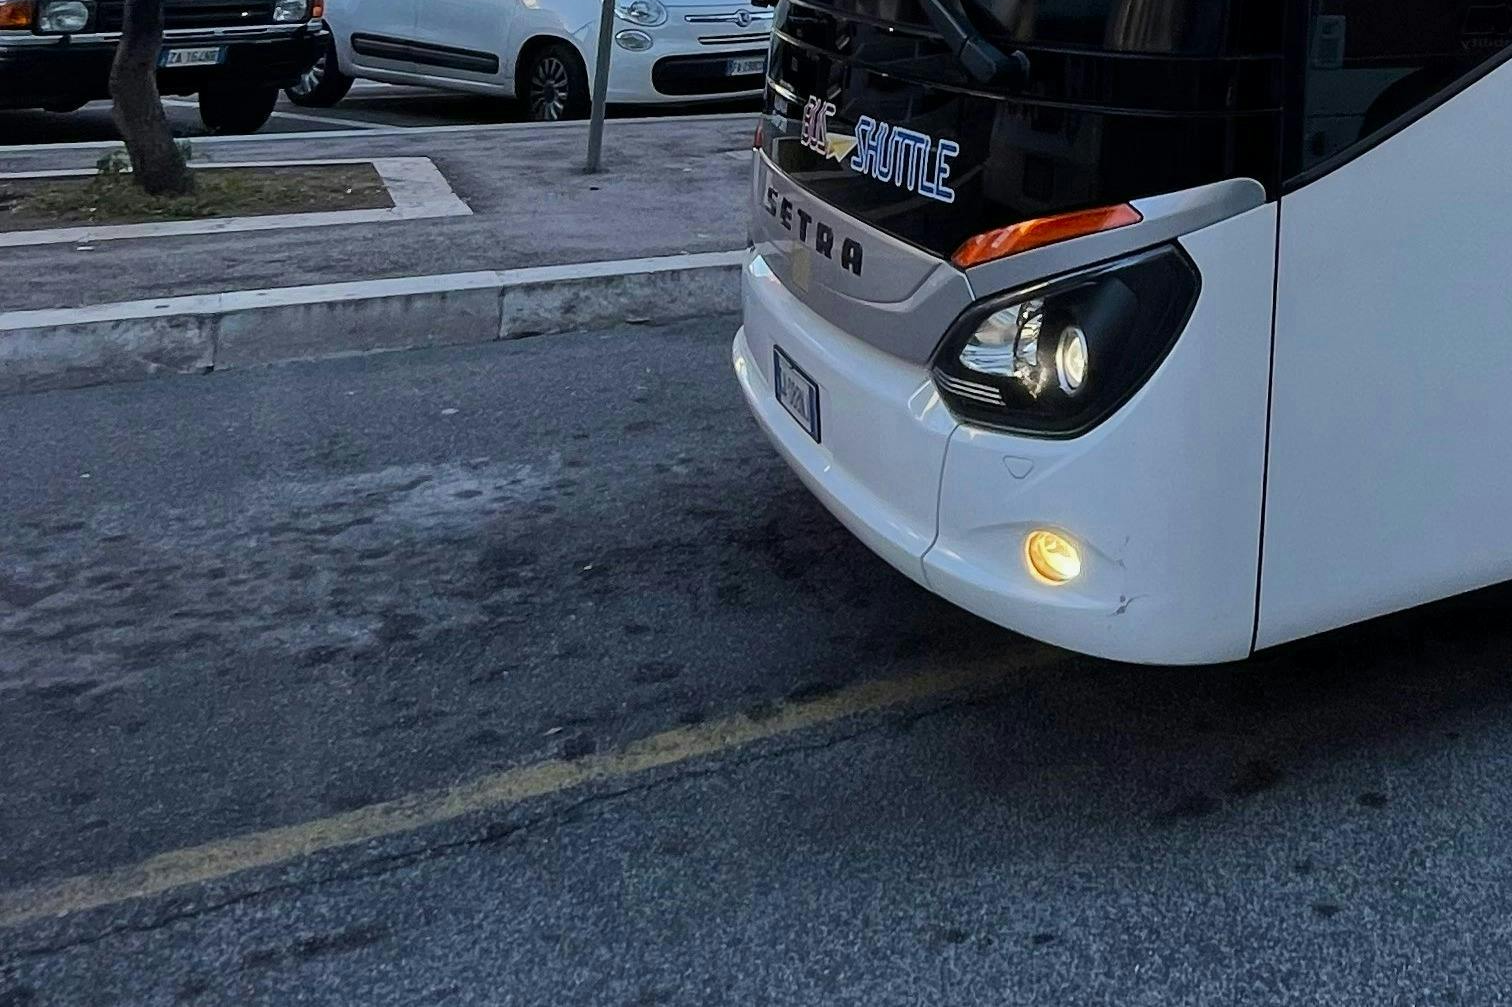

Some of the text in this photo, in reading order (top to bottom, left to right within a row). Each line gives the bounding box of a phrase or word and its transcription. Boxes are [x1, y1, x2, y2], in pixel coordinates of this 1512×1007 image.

[800, 94, 960, 204] BUS SHUTTLE
[764, 186, 864, 277] SETRA
